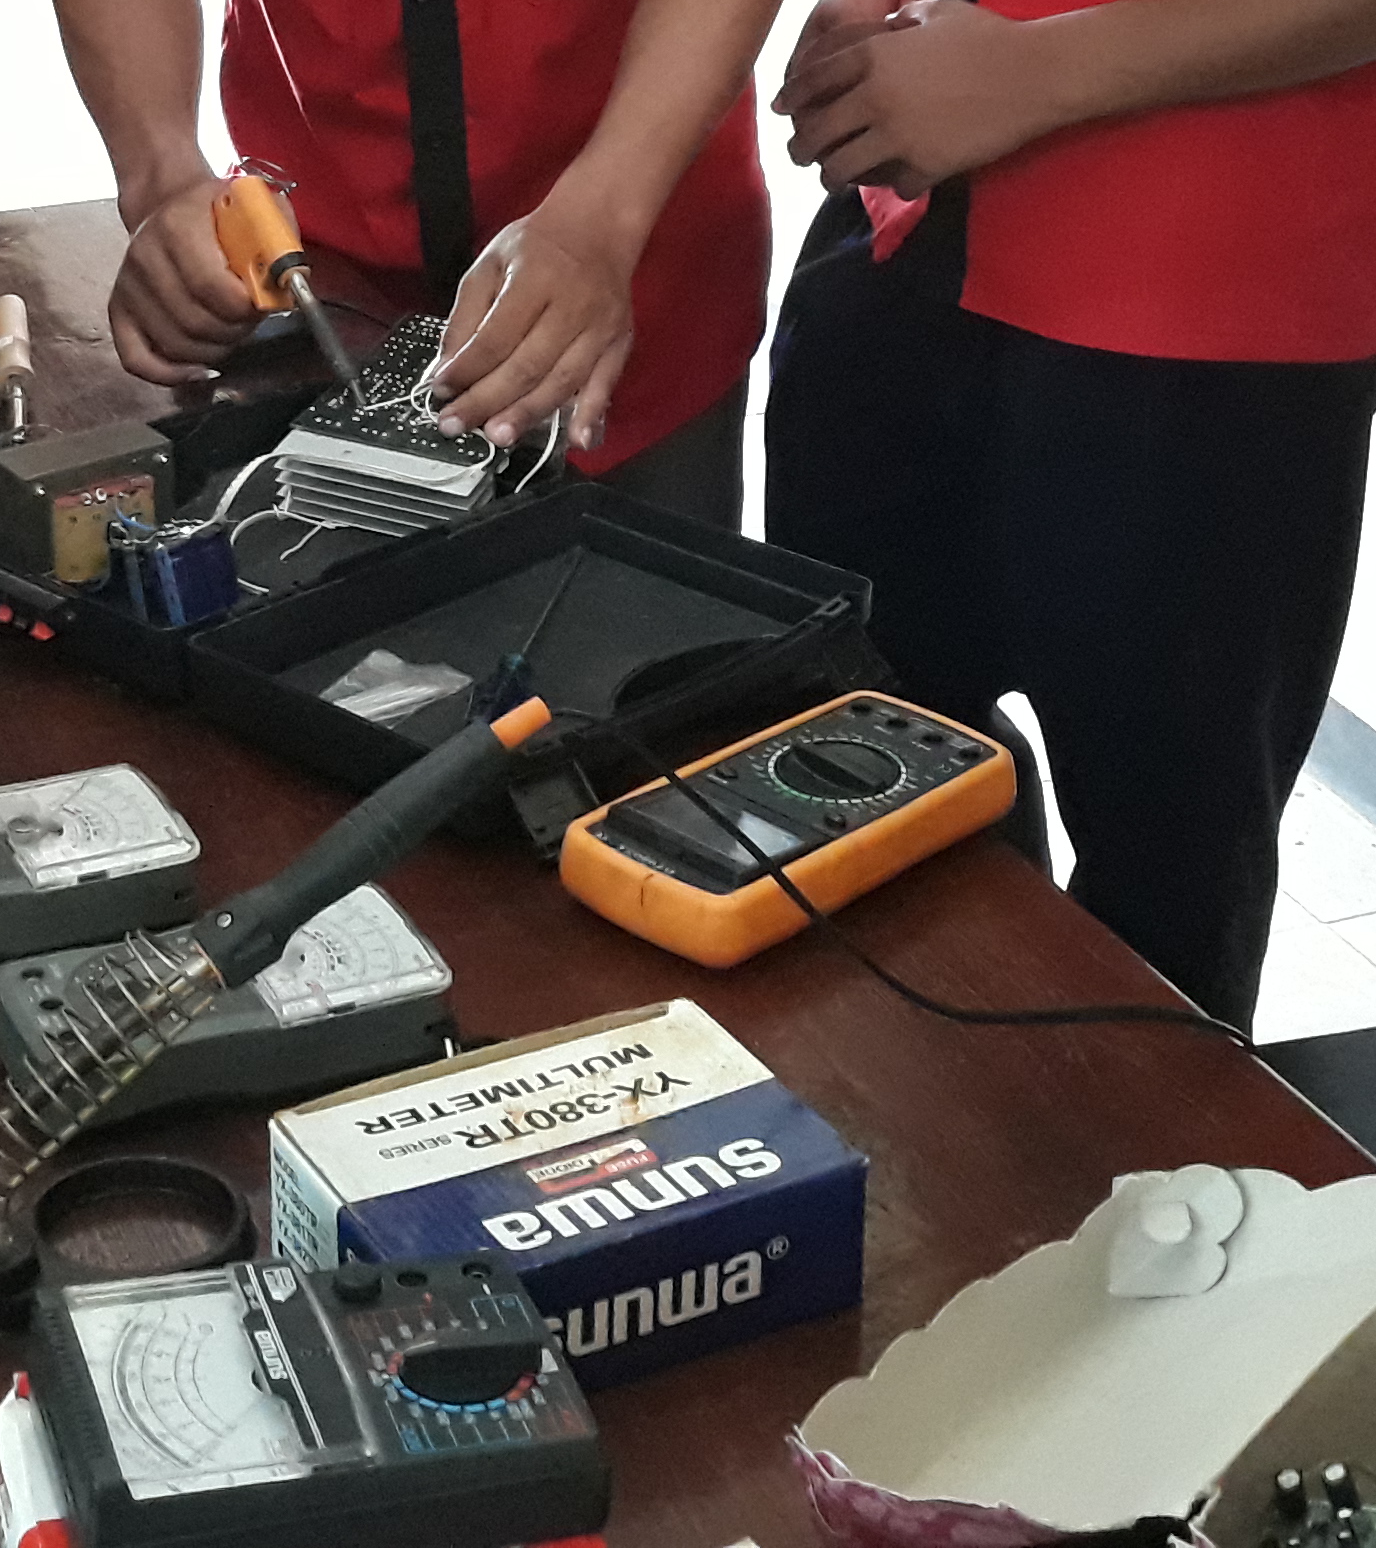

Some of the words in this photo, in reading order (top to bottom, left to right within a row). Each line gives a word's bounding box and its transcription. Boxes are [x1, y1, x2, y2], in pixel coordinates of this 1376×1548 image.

[354, 1043, 655, 1136] MULTIMETER
[452, 1070, 693, 1149] YX-380TR
[378, 1133, 453, 1160] SERIES
[481, 1137, 783, 1252] sunwa
